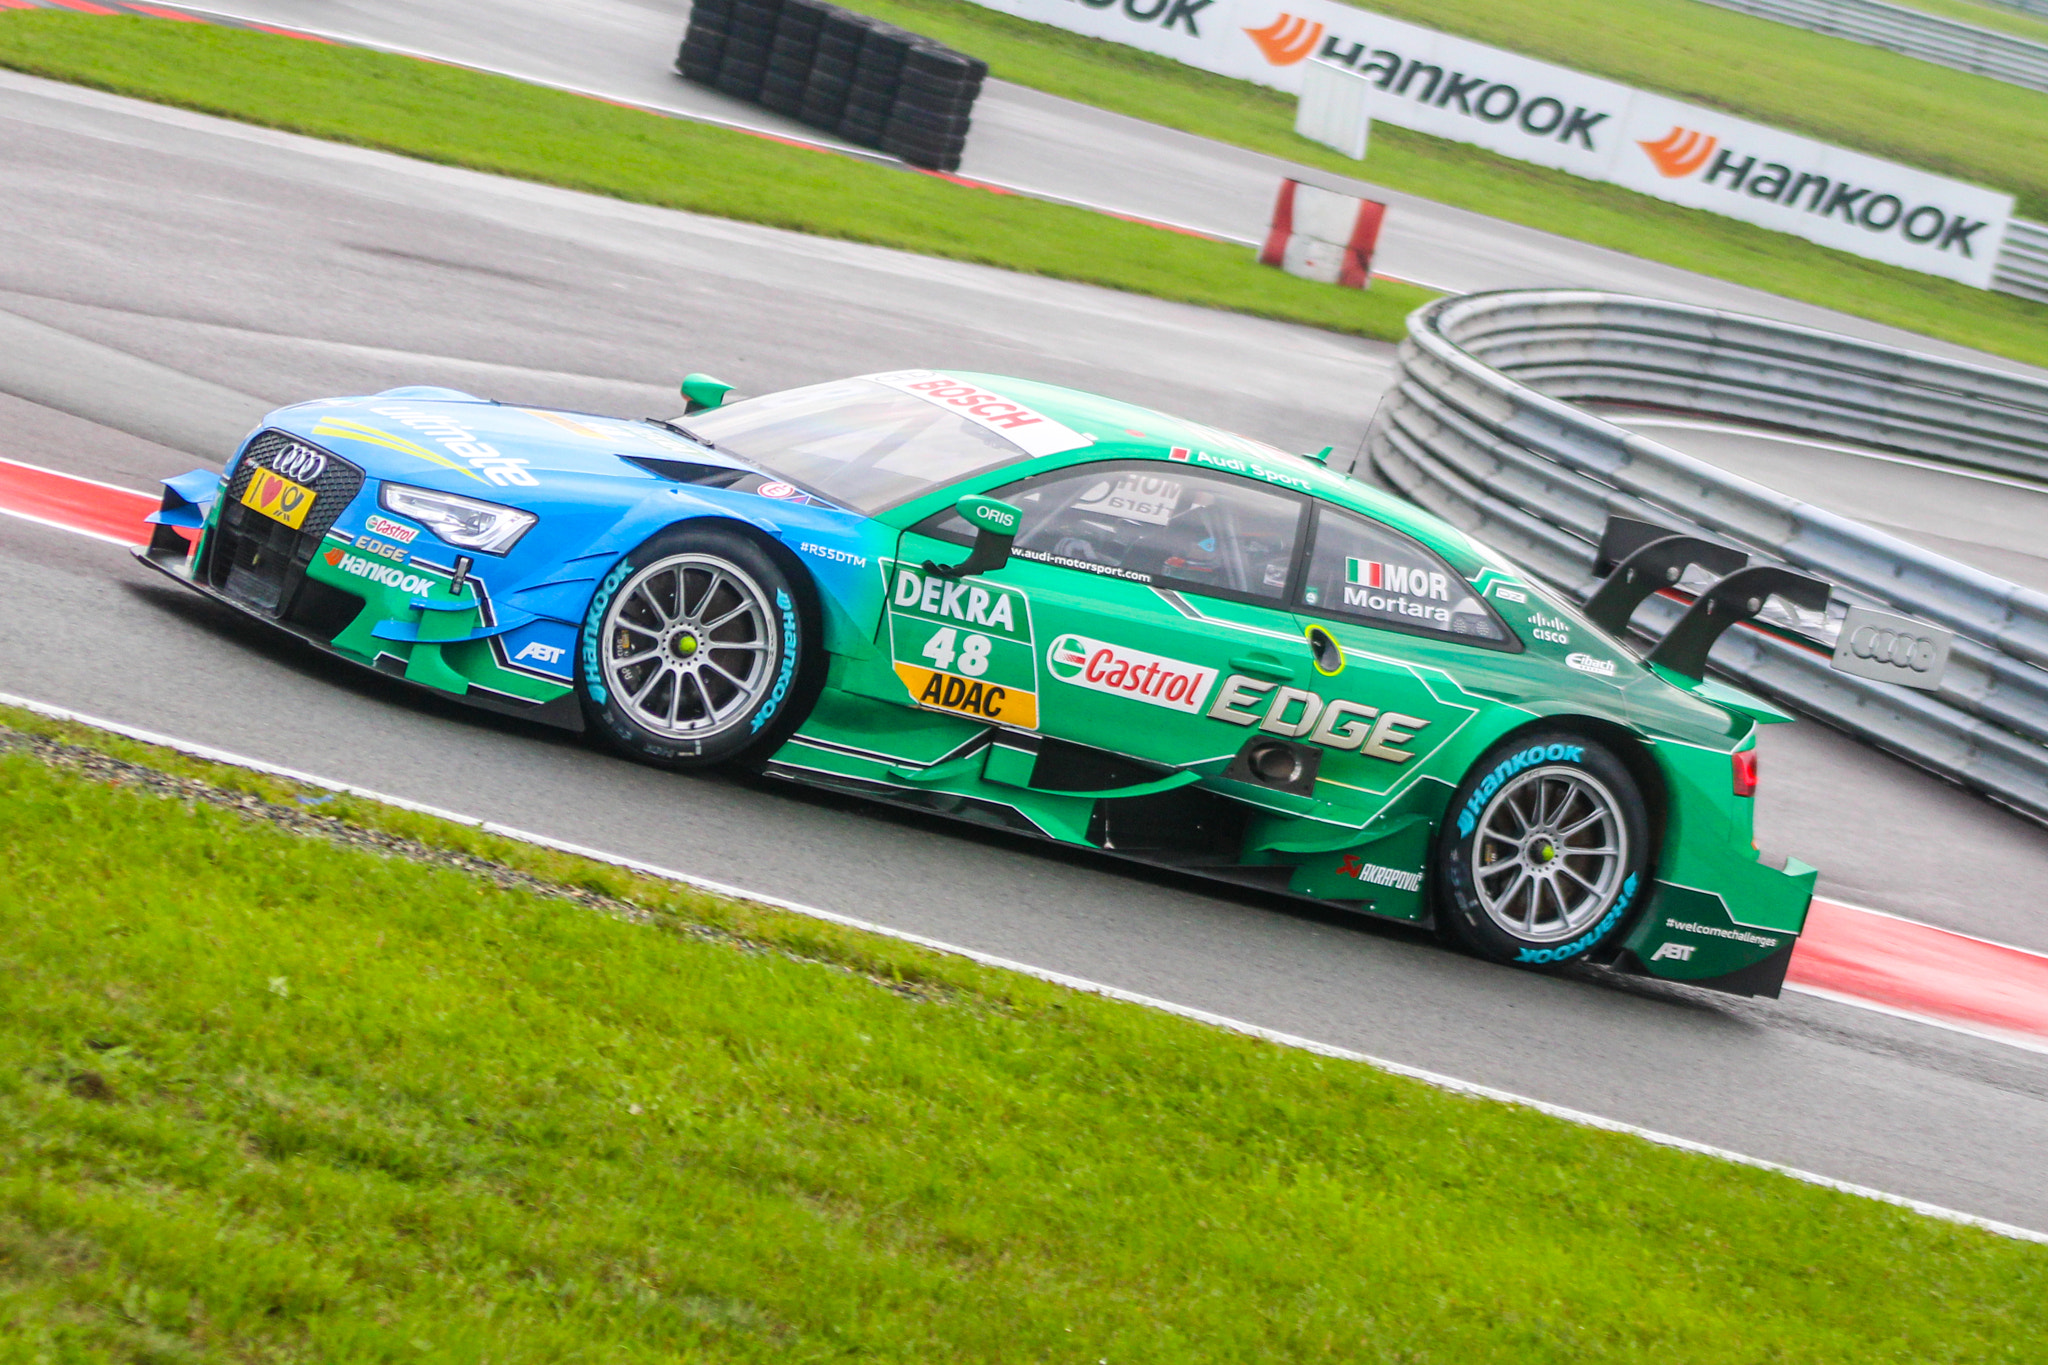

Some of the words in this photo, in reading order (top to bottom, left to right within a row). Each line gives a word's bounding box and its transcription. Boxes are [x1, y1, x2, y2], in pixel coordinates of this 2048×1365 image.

[906, 379, 1044, 429] BOSCH
[1197, 451, 1247, 473] Audi
[1250, 463, 1312, 491] Sport
[375, 519, 416, 543] Castrol
[976, 505, 1015, 527] ORIS
[354, 535, 409, 563] EDGE
[800, 541, 867, 568] #RS5DTM
[1384, 563, 1449, 602] MOR
[894, 570, 1015, 633] DEKRA
[1343, 586, 1450, 622] Mortara
[514, 641, 566, 664] ABT
[921, 626, 993, 677] 48
[1565, 652, 1615, 675] Eibach
[920, 672, 1006, 718] ADAC
[1084, 647, 1205, 707] Castrol
[1205, 673, 1433, 765] EDGE
[1665, 917, 1778, 948] #welcomechallenges
[1649, 942, 1696, 961] ABT
